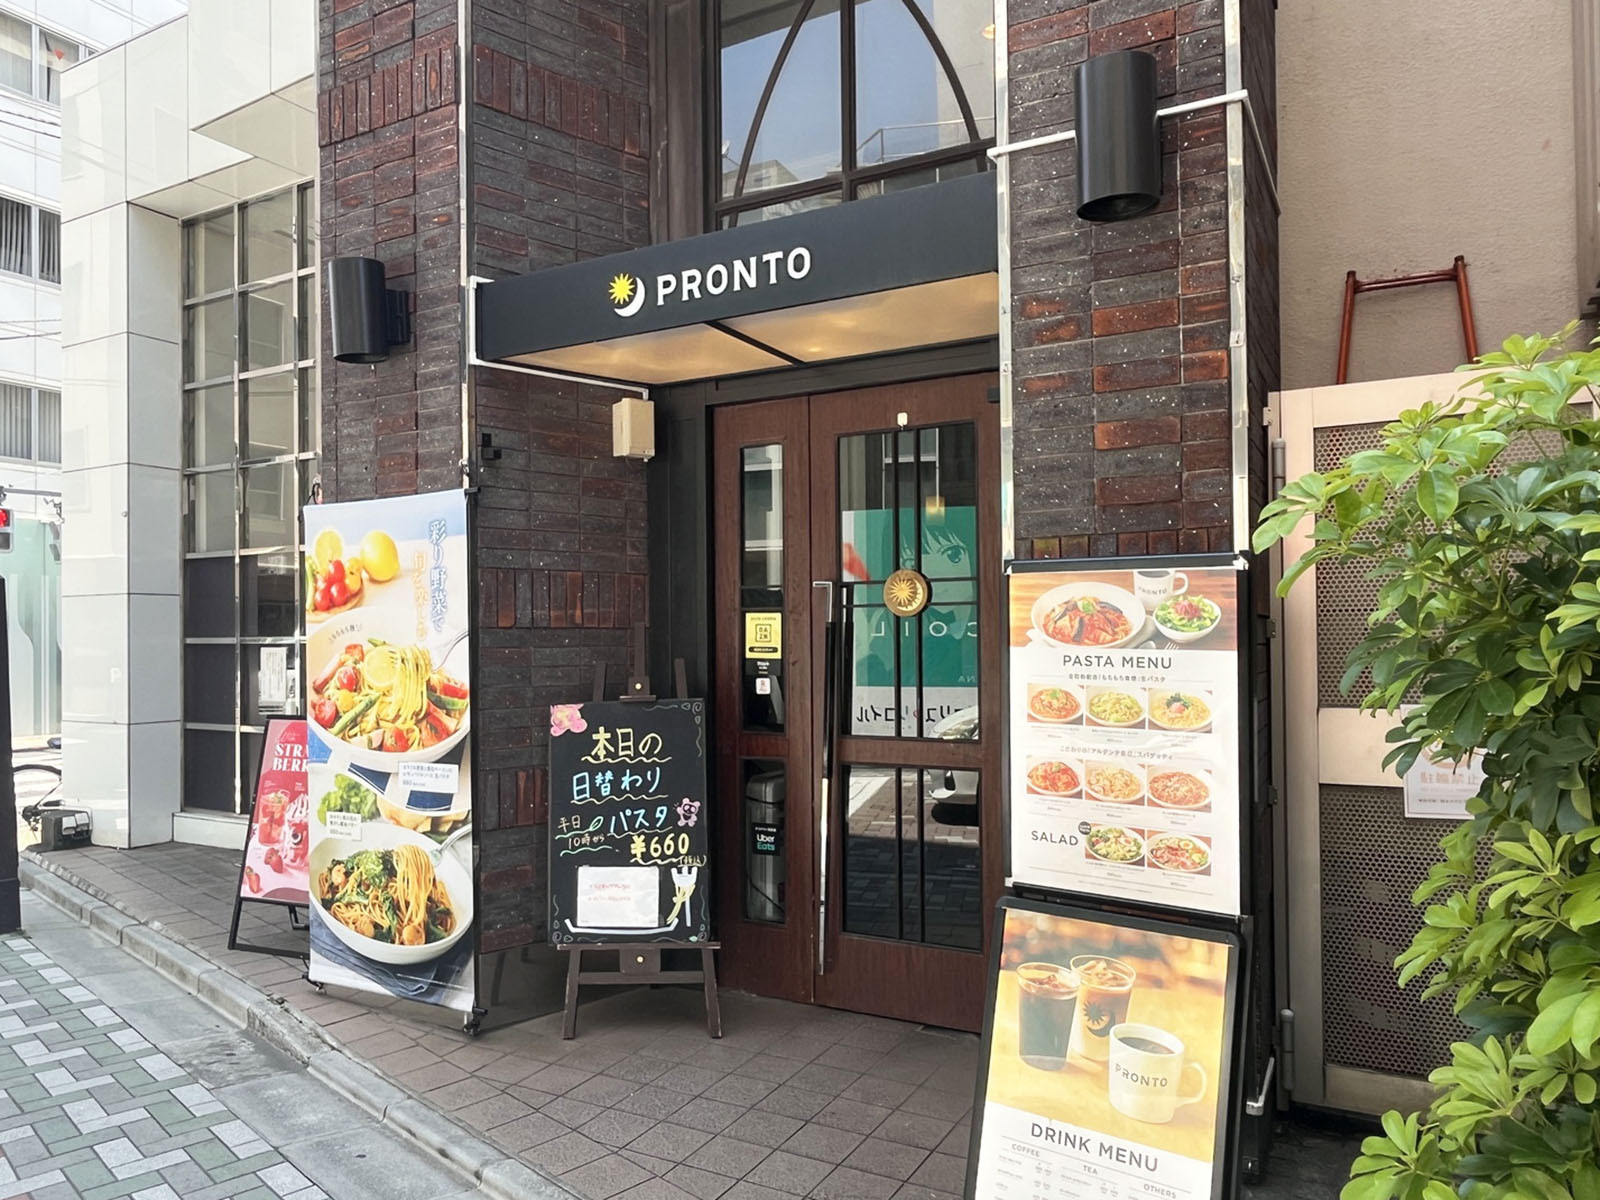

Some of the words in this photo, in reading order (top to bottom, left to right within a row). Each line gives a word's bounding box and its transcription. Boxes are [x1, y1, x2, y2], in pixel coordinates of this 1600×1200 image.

[656, 247, 811, 306] PRONTO
[429, 519, 447, 632] 彩り野菜で
[1063, 654, 1114, 668] PASTA
[1122, 656, 1172, 670] MENU
[591, 726, 662, 760] 本日の
[573, 767, 661, 800] 日替わり
[558, 815, 581, 832] 平日
[609, 806, 668, 833] パスタ
[568, 833, 605, 850] 10時から
[630, 833, 690, 859] ¥660
[756, 834, 775, 843] Uber
[757, 842, 776, 851] Eats
[1031, 830, 1079, 846] SALAD
[1115, 1063, 1168, 1088] PRONTO
[1011, 1143, 1041, 1158] COFFEE
[1031, 1122, 1091, 1154] DRINK
[1099, 1142, 1159, 1172] MENU
[1082, 1164, 1099, 1176] TEA
[1142, 1183, 1177, 1199] OTHERS
